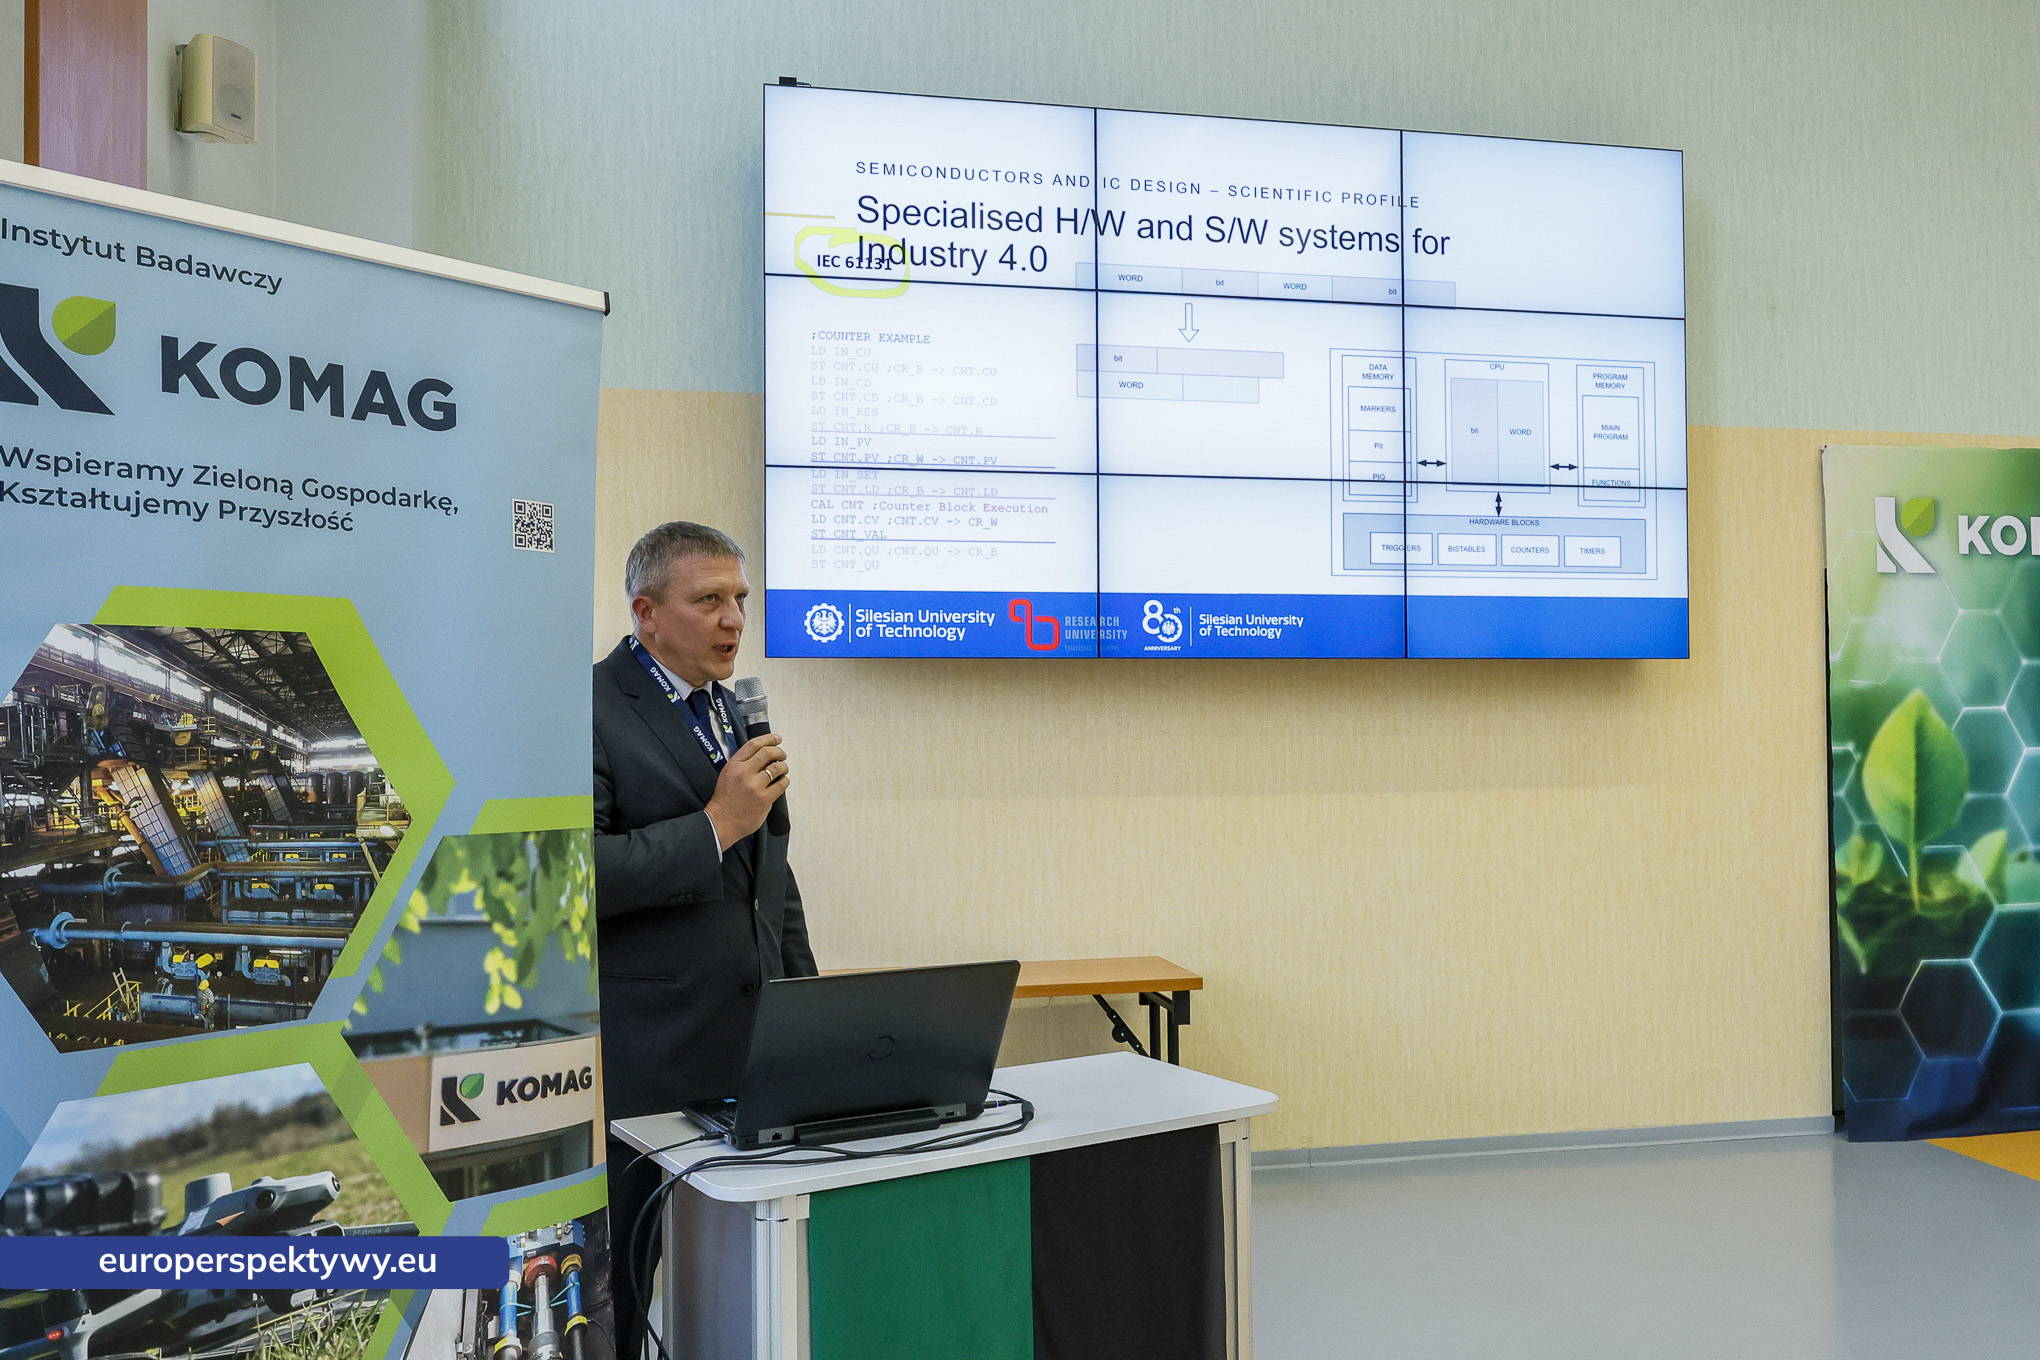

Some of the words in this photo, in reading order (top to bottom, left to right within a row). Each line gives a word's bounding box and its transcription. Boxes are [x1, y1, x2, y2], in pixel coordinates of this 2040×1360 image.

[856, 161, 1044, 185] SEMICONDUCTORS
[1052, 174, 1091, 188] AND
[1102, 177, 1121, 190] IC
[1130, 178, 1202, 195] DESIGN
[1227, 185, 1333, 204] SCIENTIFIC
[1341, 191, 1420, 209] PROFILE
[857, 194, 1043, 232] Specialised
[1056, 207, 1126, 236] H/W
[1137, 215, 1194, 241] and
[1205, 216, 1269, 244] S/W
[1279, 222, 1401, 255] systems
[1412, 228, 1450, 256] for
[1, 218, 126, 263] Instytut
[136, 246, 283, 295] Badawczy
[859, 235, 987, 276] Industry
[998, 243, 1048, 272] 4.0
[817, 254, 840, 267] IEC
[845, 257, 892, 271] 61131
[1118, 274, 1143, 282] WORD
[1283, 282, 1307, 290] WORD
[811, 330, 871, 342] ;COUNTER
[879, 333, 931, 344] EXAMPLE
[811, 346, 826, 356] LD
[834, 348, 871, 359] IN_CU
[811, 361, 825, 370] ST
[834, 362, 879, 372] CNT.CU
[953, 366, 997, 377] CNT.CU
[160, 335, 457, 431] KOMAG
[811, 377, 826, 386] LD
[834, 378, 872, 390] IN_CD
[1592, 373, 1628, 381] PROGRAM
[1118, 381, 1144, 389] WORD
[1595, 382, 1626, 390] MEMORY
[811, 392, 825, 401] ST
[834, 392, 879, 402] CNT.CD
[953, 396, 997, 407] CNT.CD
[811, 406, 826, 416] LD
[834, 407, 879, 419] IN_RES
[1360, 404, 1396, 413] MARKERS
[811, 422, 825, 431] ST
[1509, 428, 1532, 436] WORD
[811, 437, 826, 446] LD
[834, 438, 871, 449] IN_PV
[1593, 432, 1629, 441] PROGRAM
[811, 452, 826, 461] ST
[834, 452, 879, 463] CNT.PV
[953, 455, 998, 466] CNT.PV
[0, 445, 184, 487] Wspieramy
[192, 465, 293, 500] Zieloną
[302, 478, 458, 516] Gospodarkę,
[811, 469, 826, 479] LD
[834, 470, 879, 482] IN_SET
[1592, 479, 1631, 487] FUNCTIONS
[811, 484, 826, 493] ST
[834, 485, 880, 495] CNT.LD
[954, 488, 998, 497] CNT.LD
[0, 481, 209, 522] Kształtujemy
[219, 500, 354, 531] Przyszłość
[811, 500, 834, 510] CAL
[842, 501, 864, 510] CNT
[872, 501, 931, 512] ;Counter
[940, 503, 976, 512] Block
[983, 504, 1048, 514] Execution
[811, 515, 826, 524] LD
[834, 516, 879, 525] CNT.CV
[887, 516, 939, 526] ;CNT.CV
[969, 518, 998, 529] CR_W
[811, 530, 826, 539] ST
[811, 545, 826, 554] LD
[1381, 544, 1421, 552] TRIGGERS
[1511, 546, 1550, 554] COUNTERS
[811, 560, 826, 569] ST
[856, 609, 914, 623] Silesian
[918, 609, 995, 627] University
[1065, 616, 1120, 627] RESEARCH
[1199, 614, 1242, 625] Silesian
[1246, 614, 1303, 628] University
[856, 624, 872, 638] of
[877, 624, 966, 641] Technology
[1065, 629, 1128, 640] UNIVERSITY
[1199, 626, 1213, 637] of
[1215, 626, 1282, 639] Technology
[649, 667, 670, 692] KOMAG
[716, 698, 729, 723] KOMAG
[693, 726, 714, 752] KOMAG
[497, 1066, 592, 1106] KOMAG
